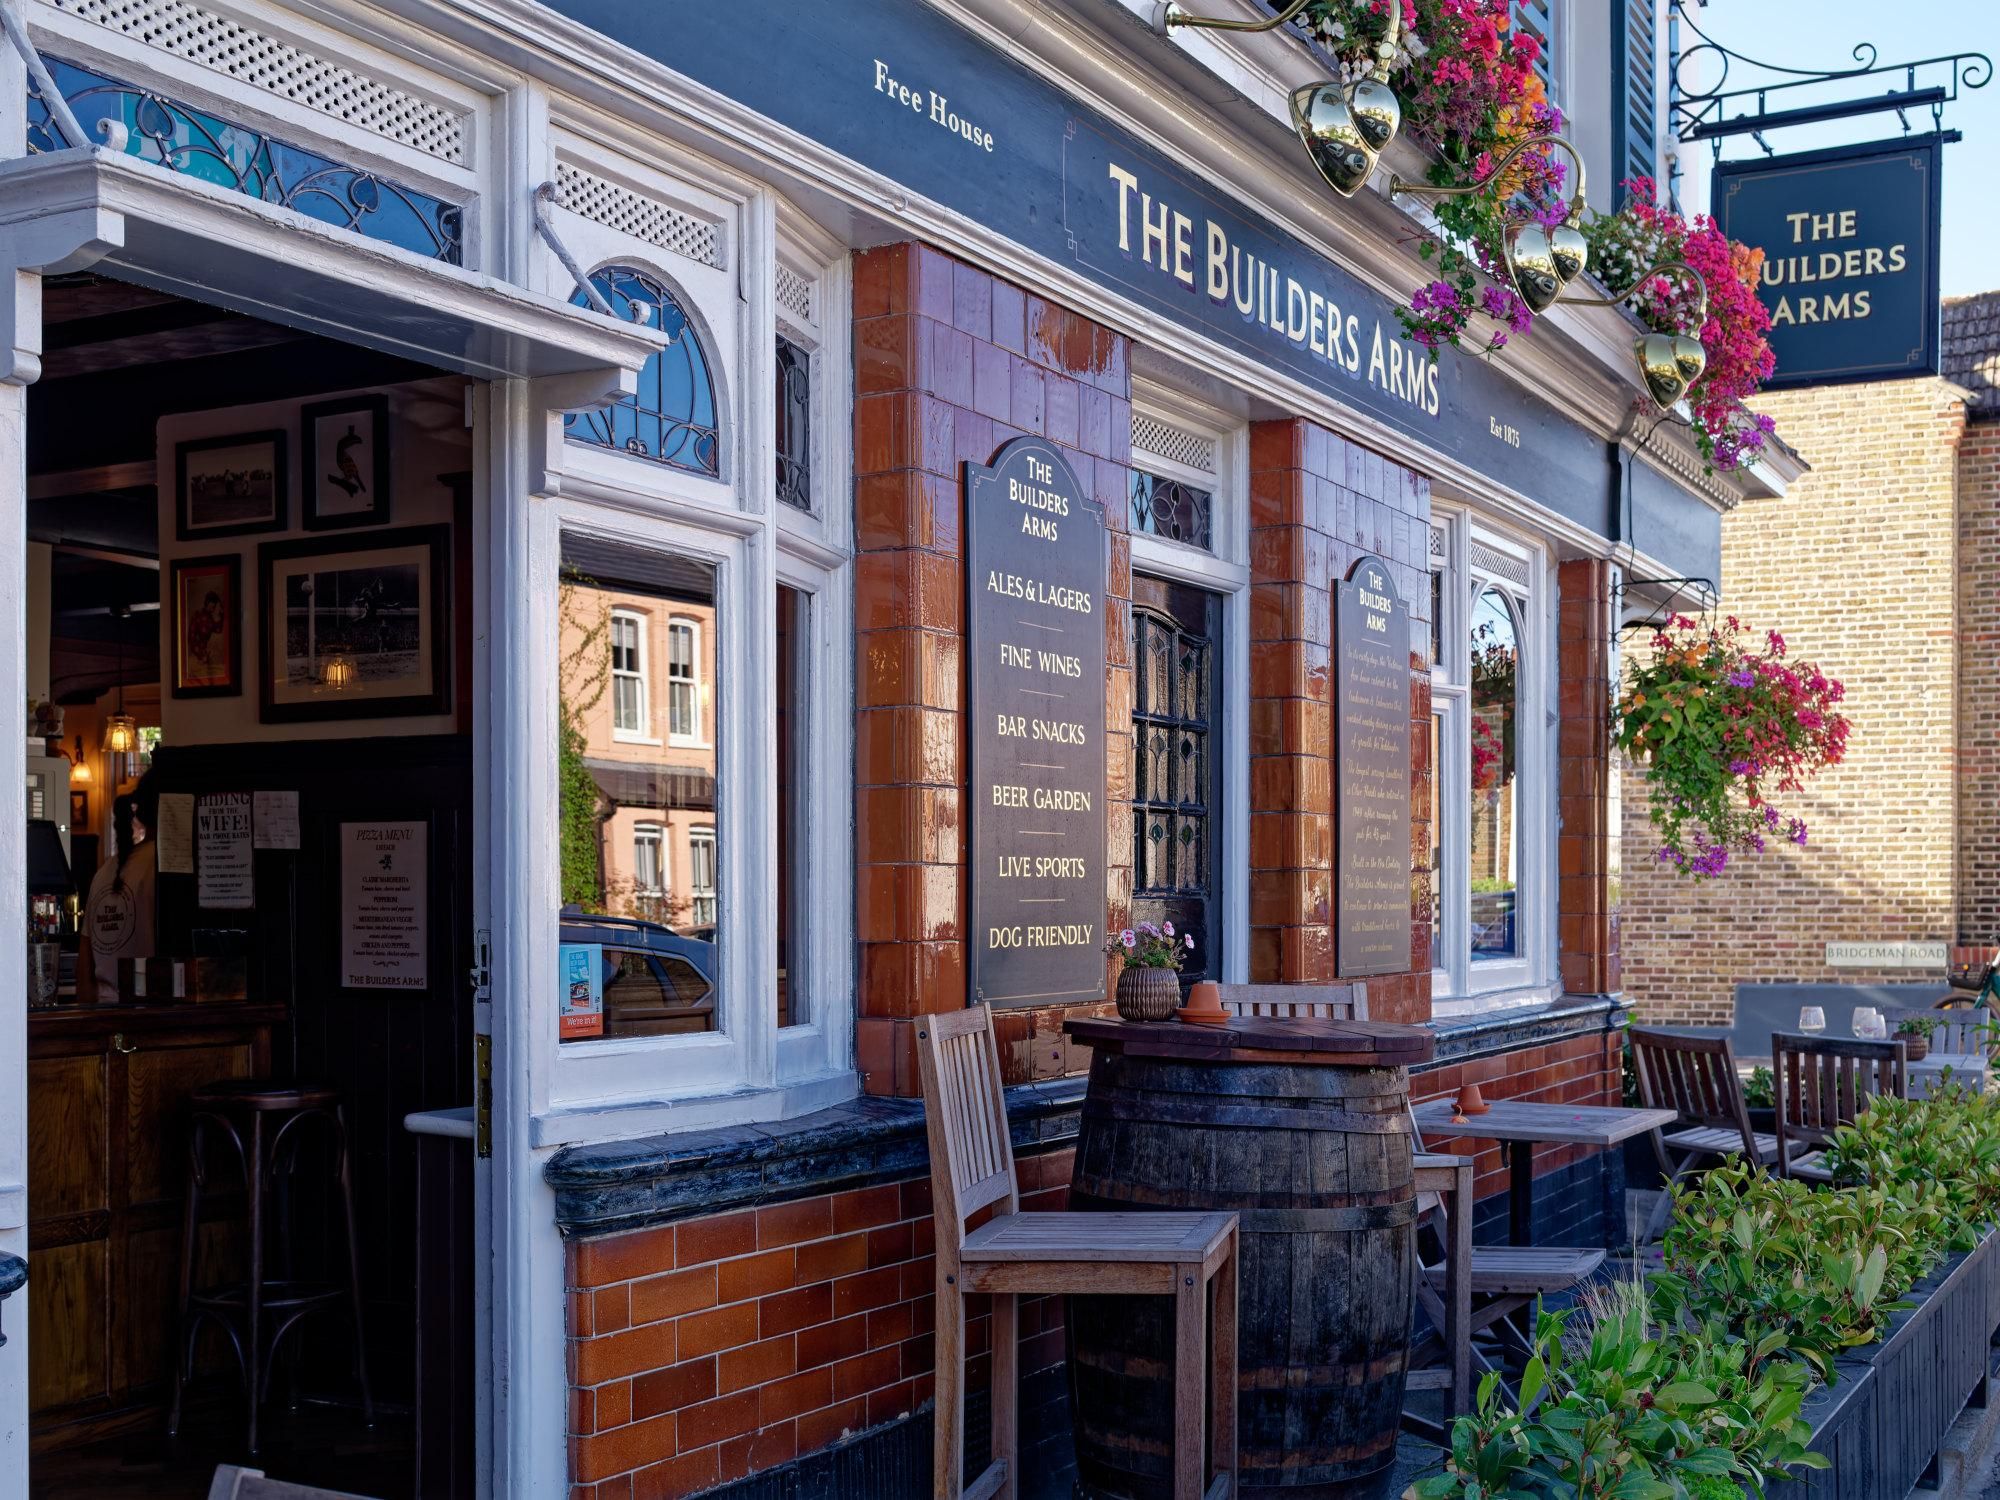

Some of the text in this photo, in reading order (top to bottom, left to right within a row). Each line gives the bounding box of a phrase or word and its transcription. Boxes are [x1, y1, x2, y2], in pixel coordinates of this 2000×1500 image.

[874, 59, 993, 152] Free House
[1787, 210, 1856, 243] THE
[1763, 244, 1906, 287] UILDERS
[1109, 162, 1439, 416] THE BUILDERS ARMS
[1771, 291, 1870, 327] ARMS
[1490, 415, 1520, 448] Est 1875
[1027, 456, 1052, 485] THE
[1009, 478, 1069, 517] BUILDERS
[1022, 512, 1058, 542] ARMS
[987, 570, 1091, 614] ALES & LAGERS
[1369, 570, 1383, 591] THE
[1359, 588, 1392, 613] BUILDERS
[1366, 611, 1386, 632] ARMS
[1001, 644, 1081, 678] FINE WINES
[997, 714, 1085, 745] BAR SNACKS
[993, 785, 1091, 812] BEER GARDEN
[200, 815, 248, 831] WIFE!
[356, 829, 414, 841] PIZZA MENU
[999, 856, 1085, 878] LIVE SPORTS
[989, 924, 1093, 949] DOG FRIENDLY
[1827, 947, 1946, 959] BRIDGEMAN ROAD
[349, 975, 424, 986] THE BUILDERS ARMS
[567, 1017, 584, 1026] We're
